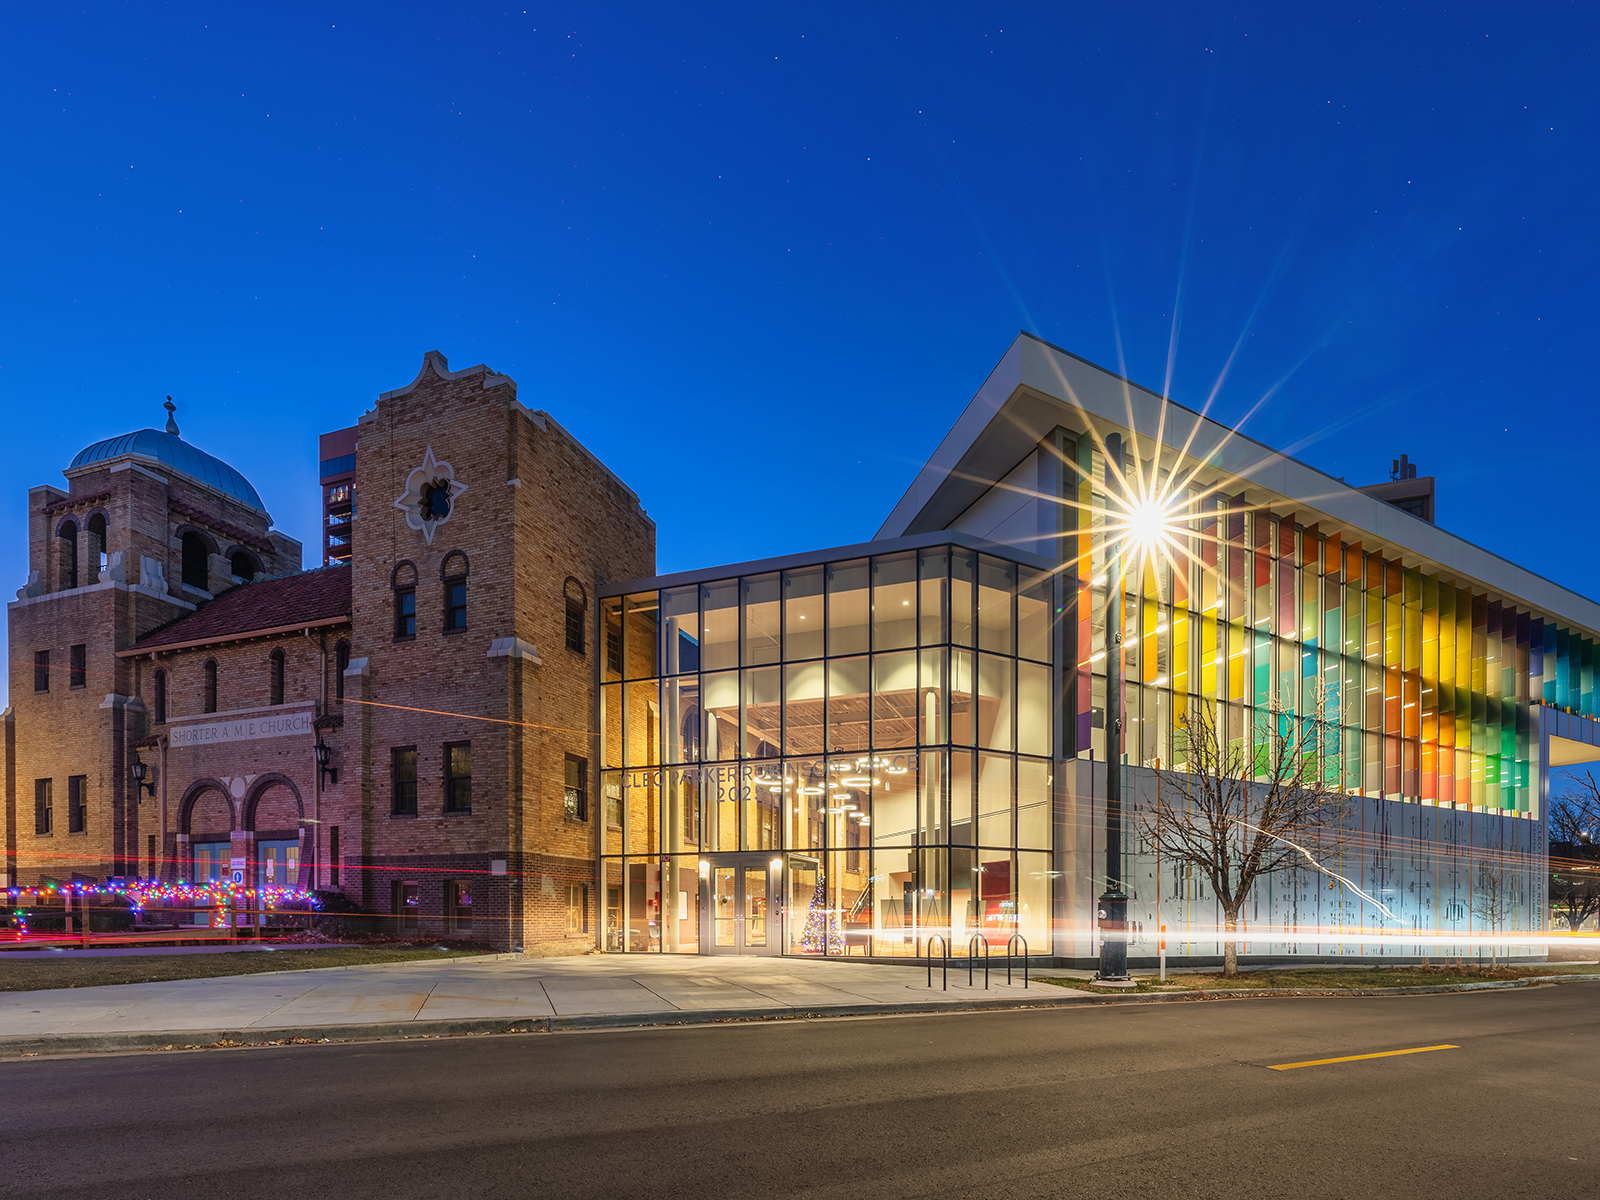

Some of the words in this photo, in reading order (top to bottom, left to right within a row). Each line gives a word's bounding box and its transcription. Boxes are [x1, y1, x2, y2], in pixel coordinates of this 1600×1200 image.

[172, 727, 218, 743] SHORTER
[260, 716, 309, 733] CHURCH
[621, 771, 665, 788] CLEO
[669, 767, 738, 785] PARKER
[742, 759, 841, 781] ROBINSON
[849, 754, 919, 774] DANCE
[716, 784, 764, 803] 2025
